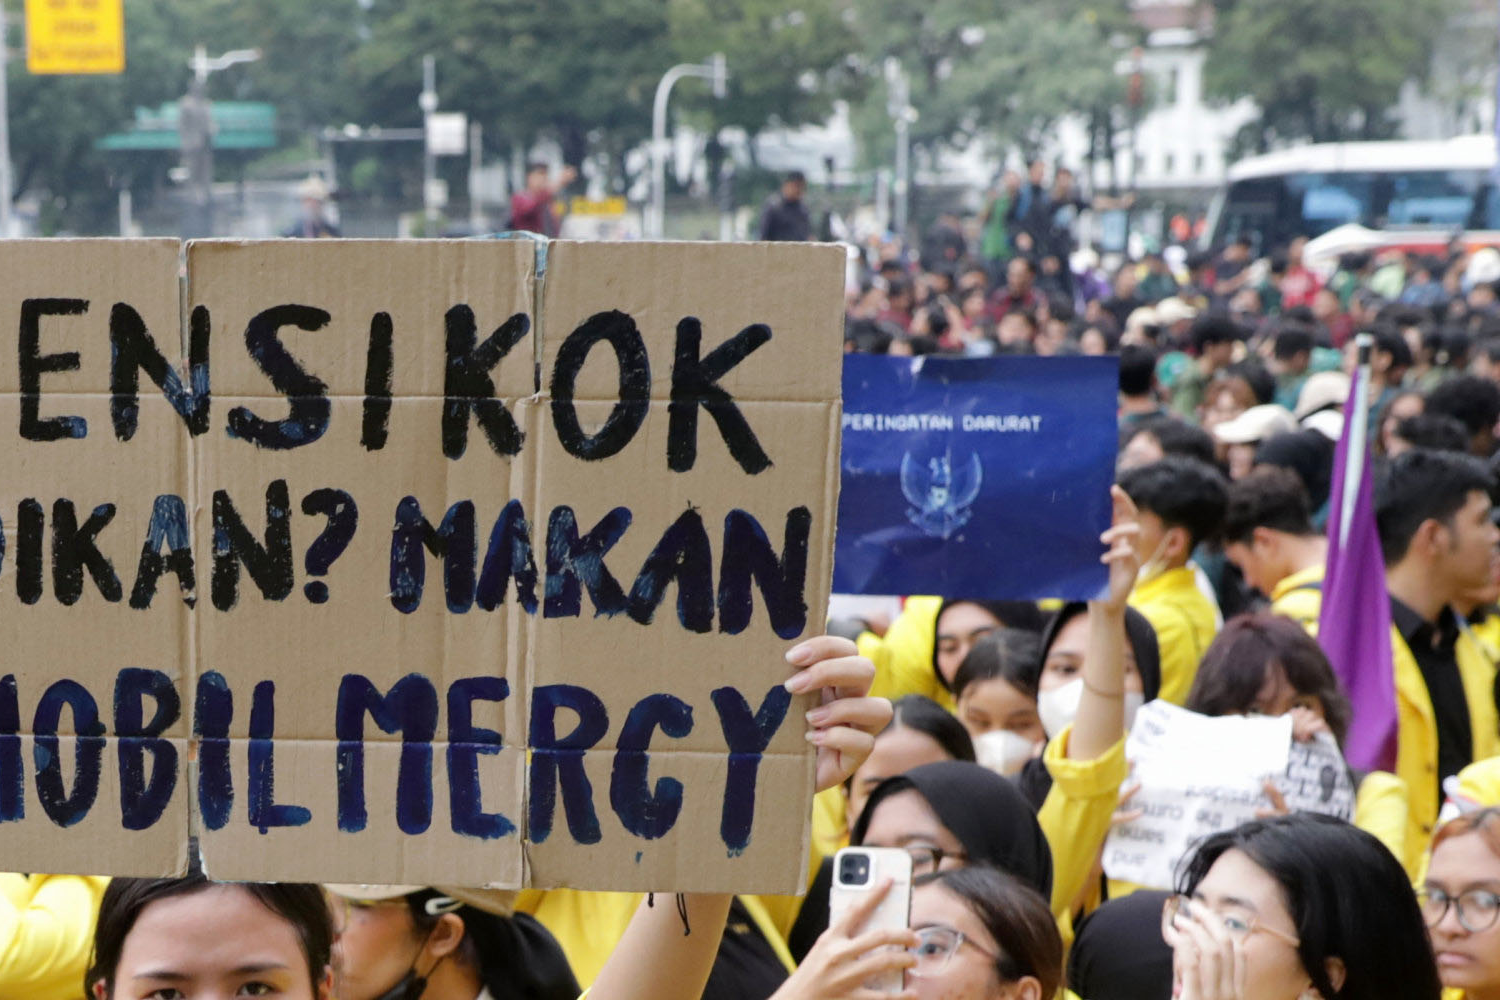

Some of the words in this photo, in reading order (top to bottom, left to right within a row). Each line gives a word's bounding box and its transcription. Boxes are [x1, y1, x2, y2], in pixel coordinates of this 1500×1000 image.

[440, 303, 775, 476] KOK
[842, 413, 953, 431] PERINGATAN
[962, 415, 1042, 432] DARURAT
[389, 496, 813, 641] MAKAN
